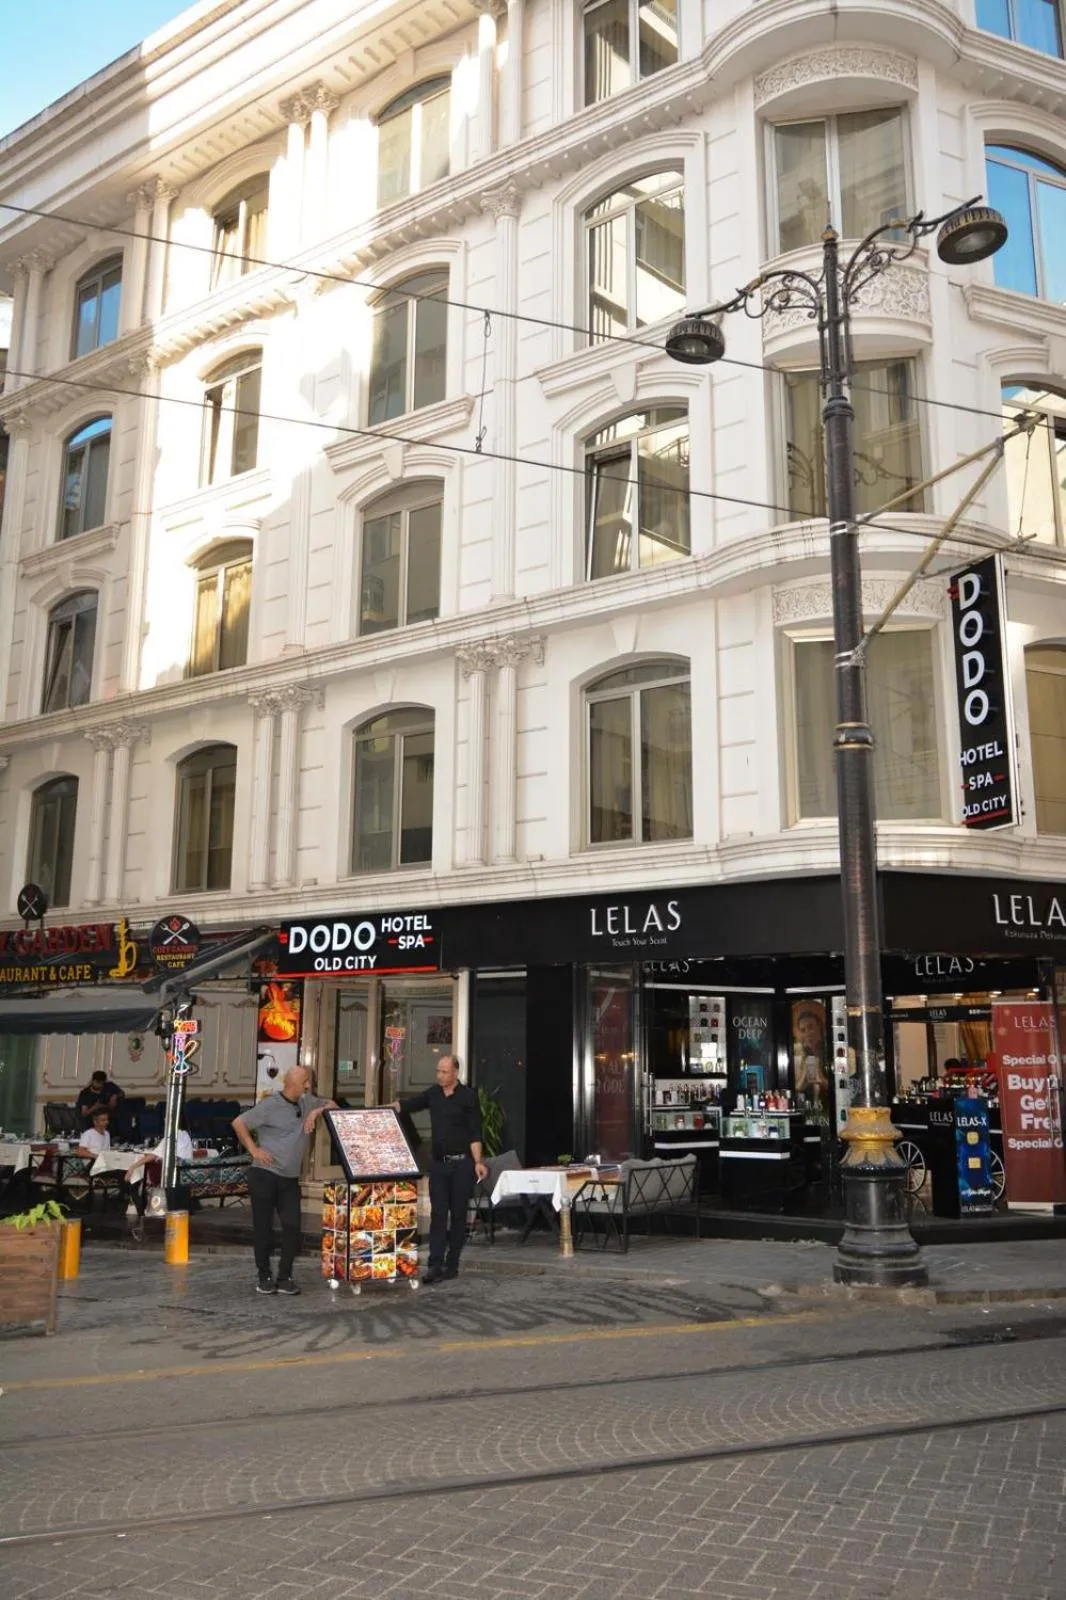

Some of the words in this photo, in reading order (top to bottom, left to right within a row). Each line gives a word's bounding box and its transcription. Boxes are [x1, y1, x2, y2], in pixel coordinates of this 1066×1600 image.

[957, 573, 989, 726] DODO
[958, 741, 1003, 767] HOTEL
[969, 771, 994, 791] SPA
[982, 795, 1007, 811] CITY
[590, 900, 681, 936] LELAS
[992, 894, 1066, 927] LELA
[289, 921, 376, 954] DODO
[381, 915, 432, 932] HOTEL
[398, 935, 425, 949] SPA
[314, 957, 342, 971] OLD
[345, 955, 377, 969] CITY
[49, 966, 57, 980] &
[59, 964, 91, 980] CAFE
[732, 1016, 768, 1028] OCEAN
[738, 1029, 763, 1040] DEEP
[1002, 1054, 1046, 1066] Special
[1007, 1074, 1045, 1093] Buy
[929, 1111, 953, 1122] LELAS
[957, 1115, 987, 1127] LELAS-X
[1007, 1138, 1052, 1150] Special
